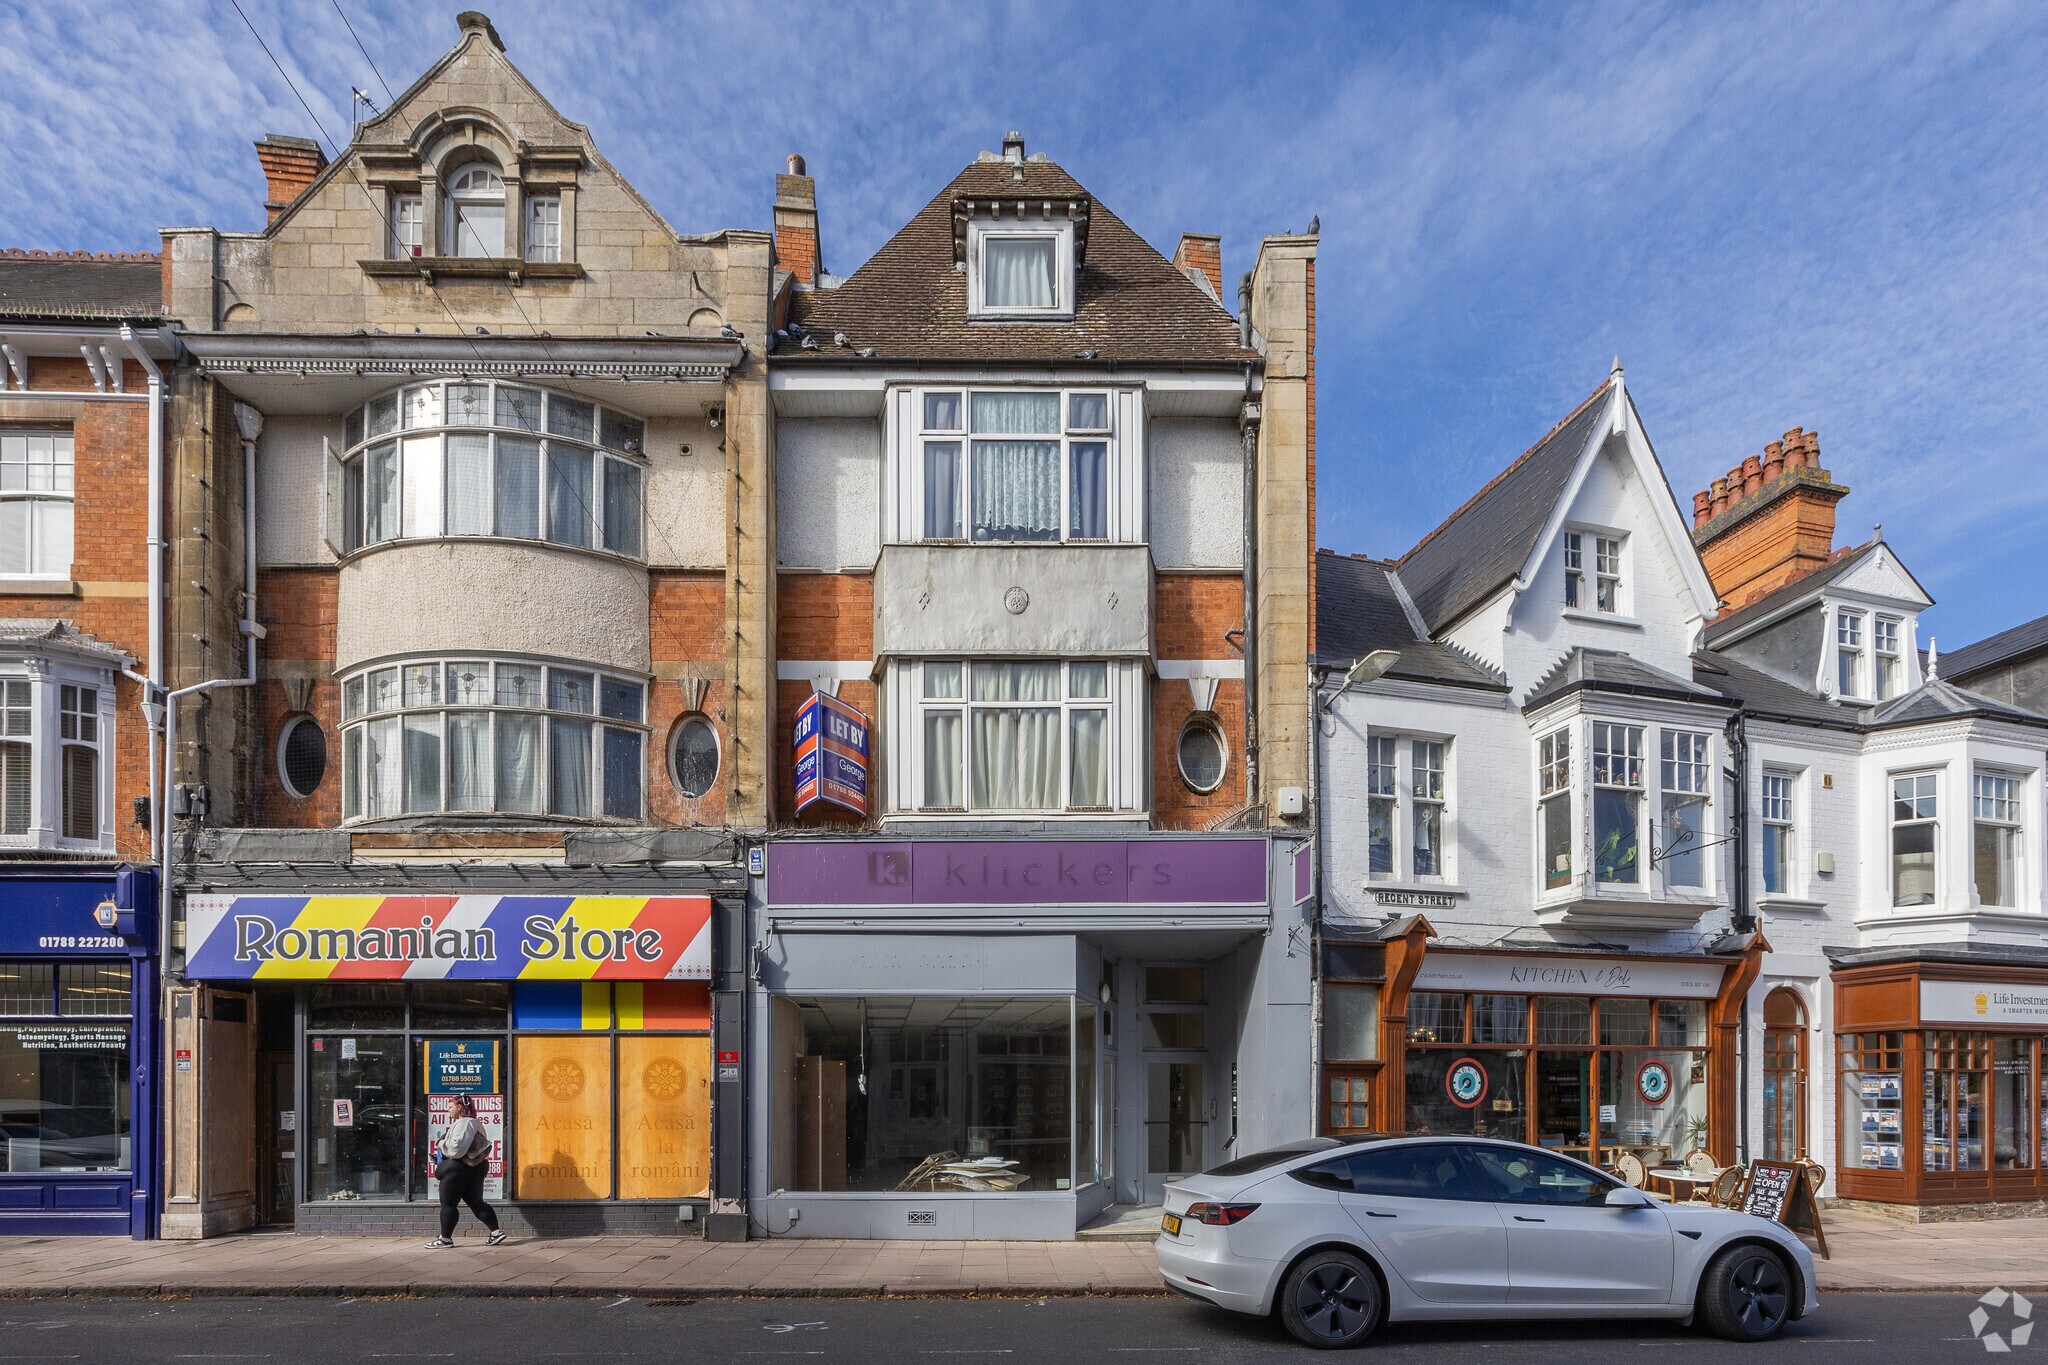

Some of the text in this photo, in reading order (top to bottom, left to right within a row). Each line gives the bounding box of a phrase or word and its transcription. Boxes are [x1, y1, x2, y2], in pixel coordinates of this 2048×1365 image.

[802, 712, 812, 737] BY
[830, 715, 864, 748] LET BY
[797, 756, 815, 776] George
[839, 758, 864, 781] George
[946, 850, 1171, 886] klickers
[1378, 892, 1453, 906] REGENT STREET
[40, 936, 124, 948] 01788 227200
[234, 914, 663, 962] Romanian Store
[1510, 966, 1590, 984] KITCHEN
[1604, 966, 1631, 988] Deli
[1993, 992, 2010, 1004] Life
[441, 1065, 482, 1074] TO LET
[432, 1114, 445, 1125] All
[492, 1114, 500, 1125] &
[536, 1115, 592, 1130] Acasă
[638, 1115, 694, 1130] Acasă
[556, 1138, 572, 1154] la
[658, 1138, 674, 1154] la
[530, 1161, 598, 1178] români
[632, 1161, 700, 1178] români
[1762, 1178, 1780, 1188] OPEN
